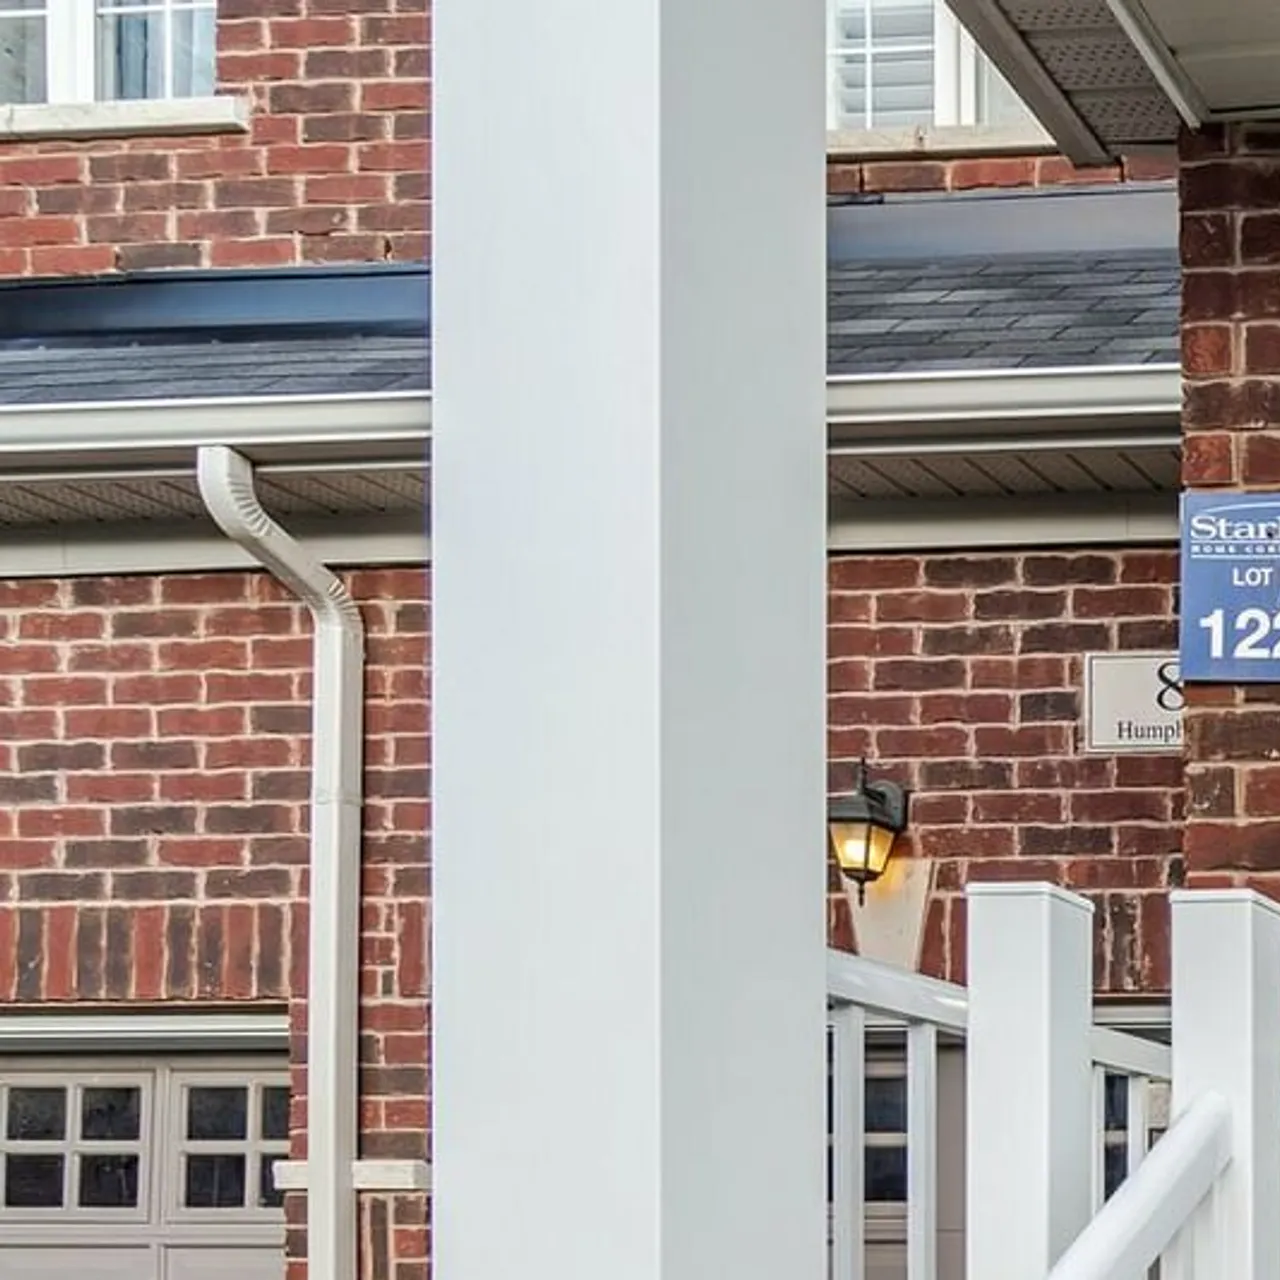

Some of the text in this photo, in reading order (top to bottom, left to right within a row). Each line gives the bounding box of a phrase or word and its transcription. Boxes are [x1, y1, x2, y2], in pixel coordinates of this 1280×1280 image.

[1191, 545, 1237, 553] HOME
[1232, 566, 1274, 586] LOT
[1156, 662, 1185, 711] 8
